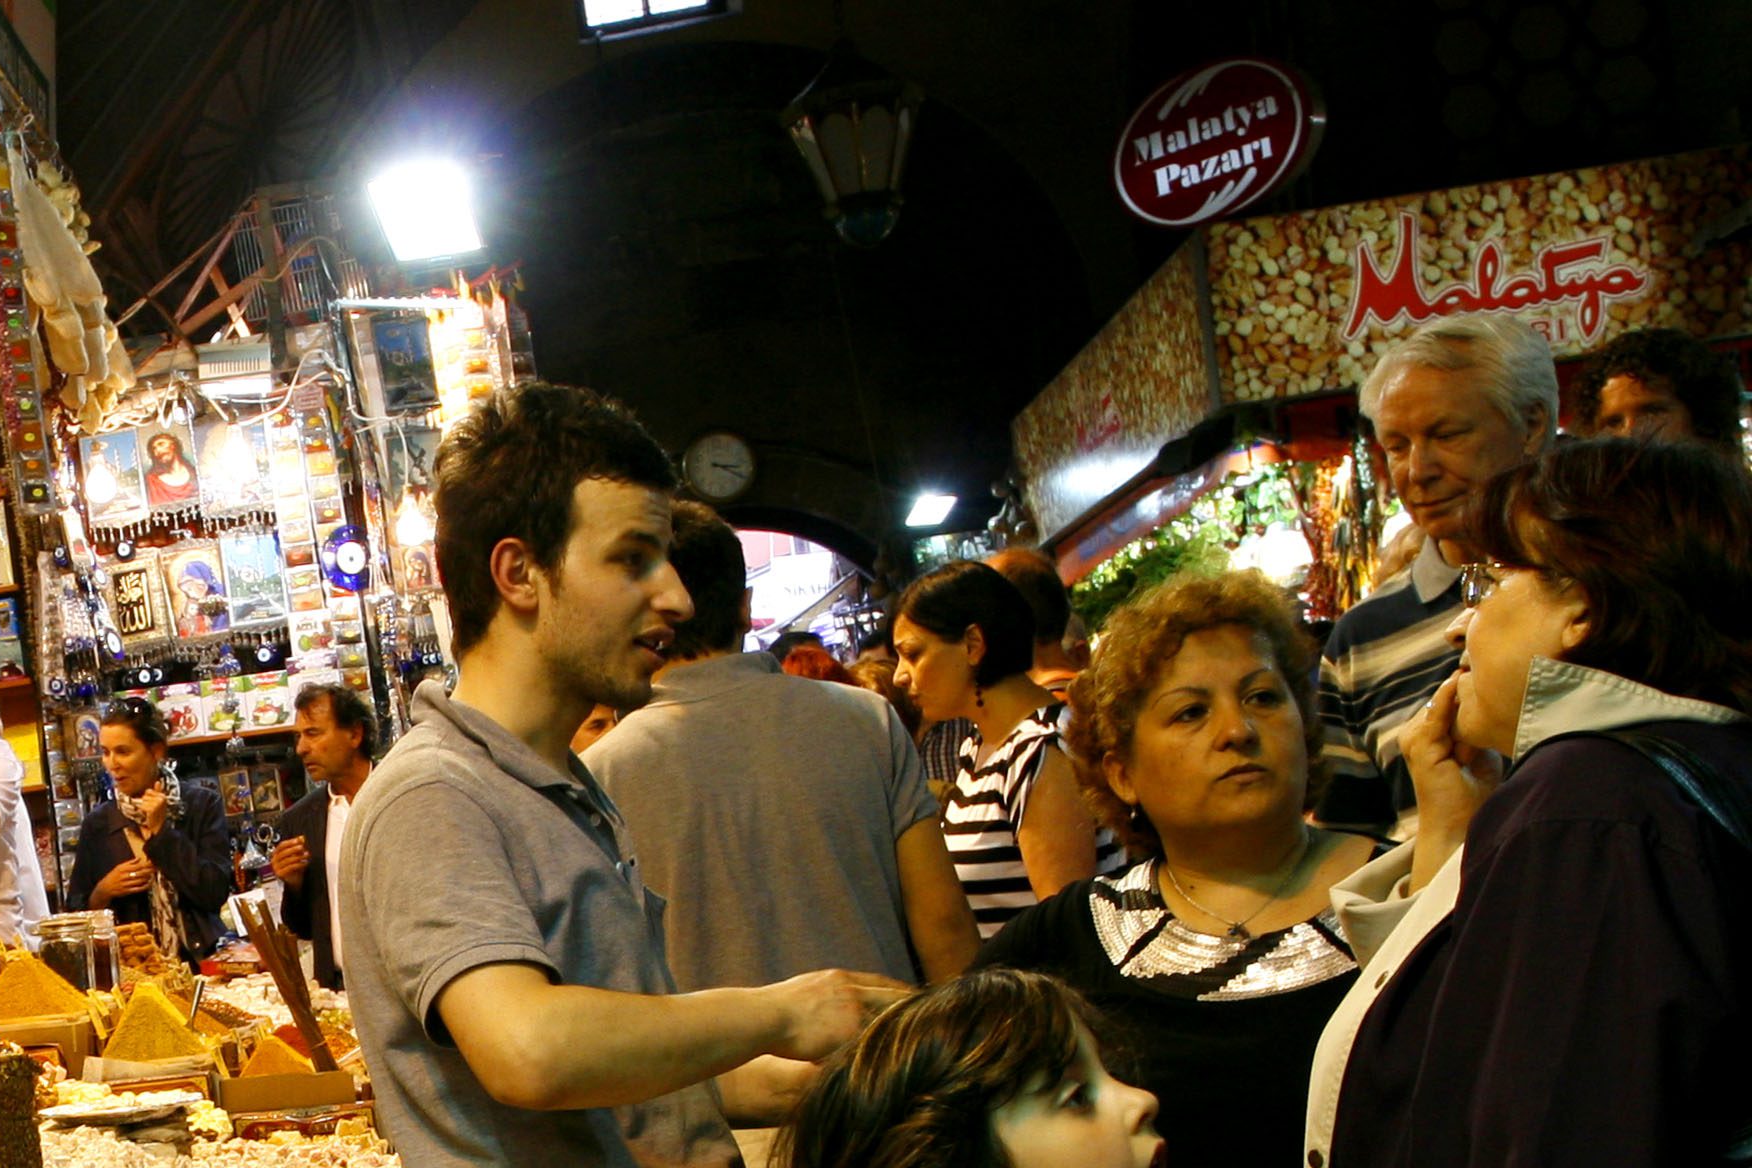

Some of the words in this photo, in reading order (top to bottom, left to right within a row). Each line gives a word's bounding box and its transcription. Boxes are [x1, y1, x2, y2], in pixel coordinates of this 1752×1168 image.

[1133, 96, 1279, 167] Malatya
[1153, 136, 1273, 198] Pazarı
[1341, 210, 1649, 343] Malatya
